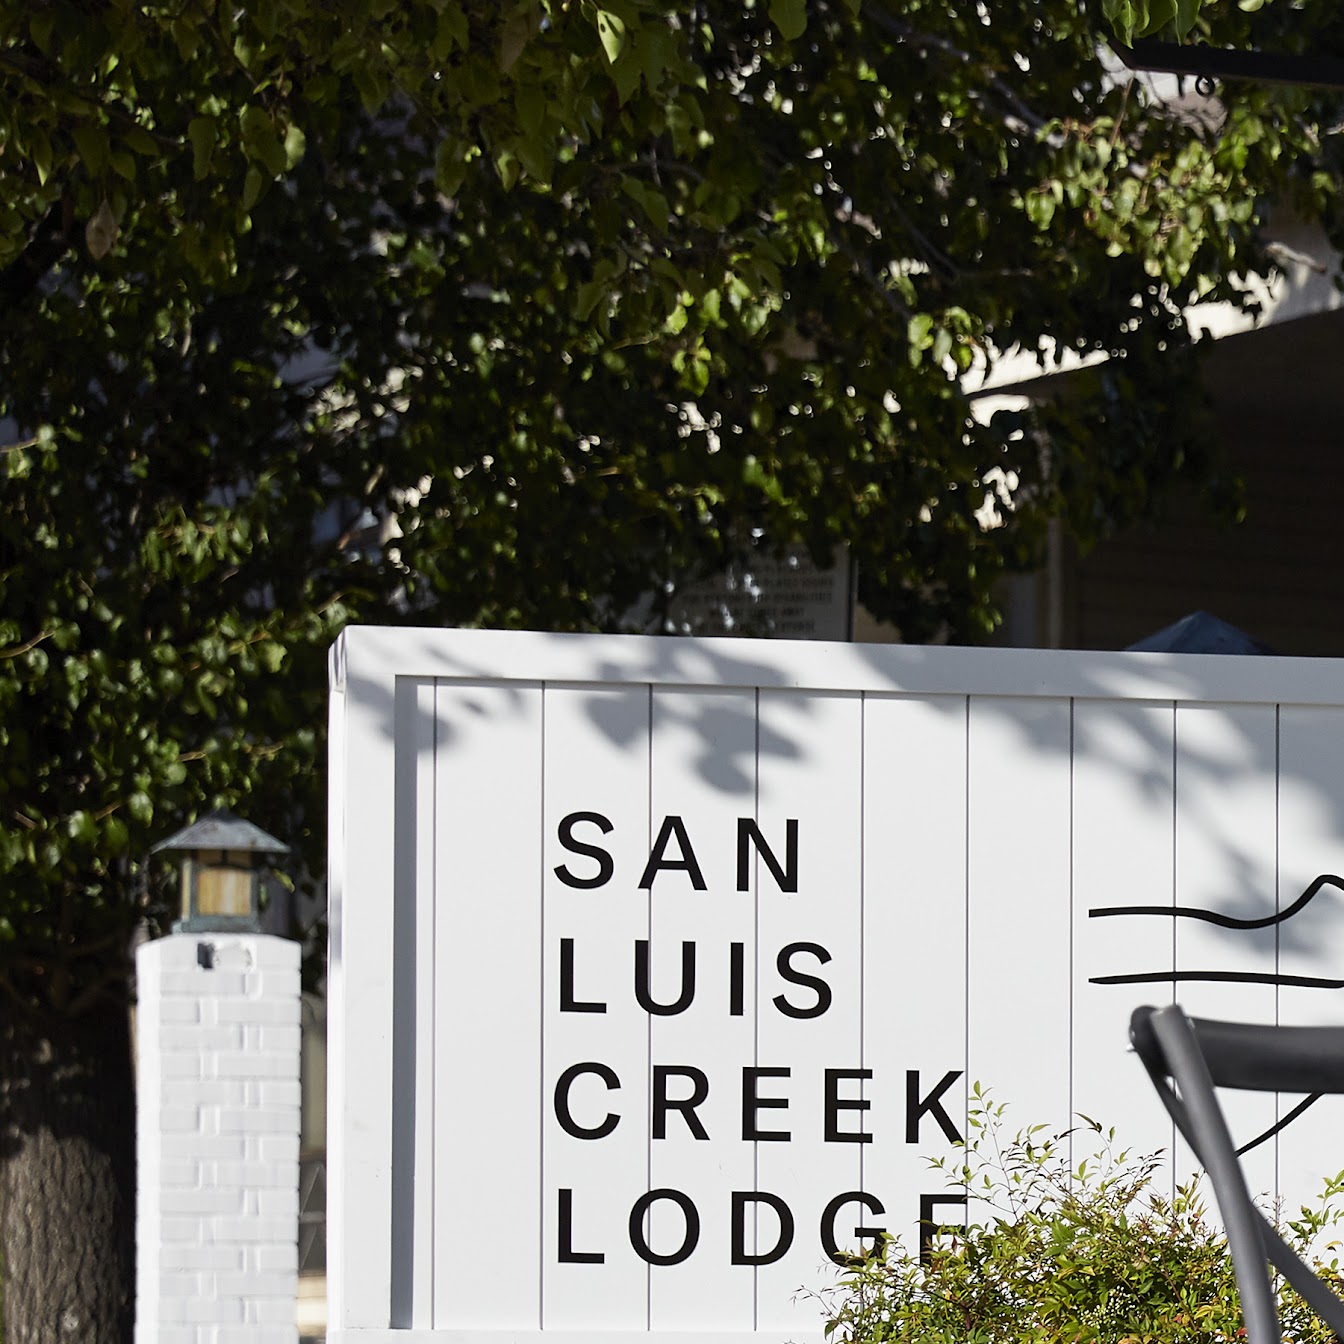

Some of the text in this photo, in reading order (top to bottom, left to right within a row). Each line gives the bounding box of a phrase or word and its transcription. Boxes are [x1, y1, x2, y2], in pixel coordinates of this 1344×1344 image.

[553, 811, 799, 893] SAN
[559, 938, 833, 1019] LUIS
[553, 1062, 965, 1145] CREEK
[557, 1188, 968, 1268] LODGE
